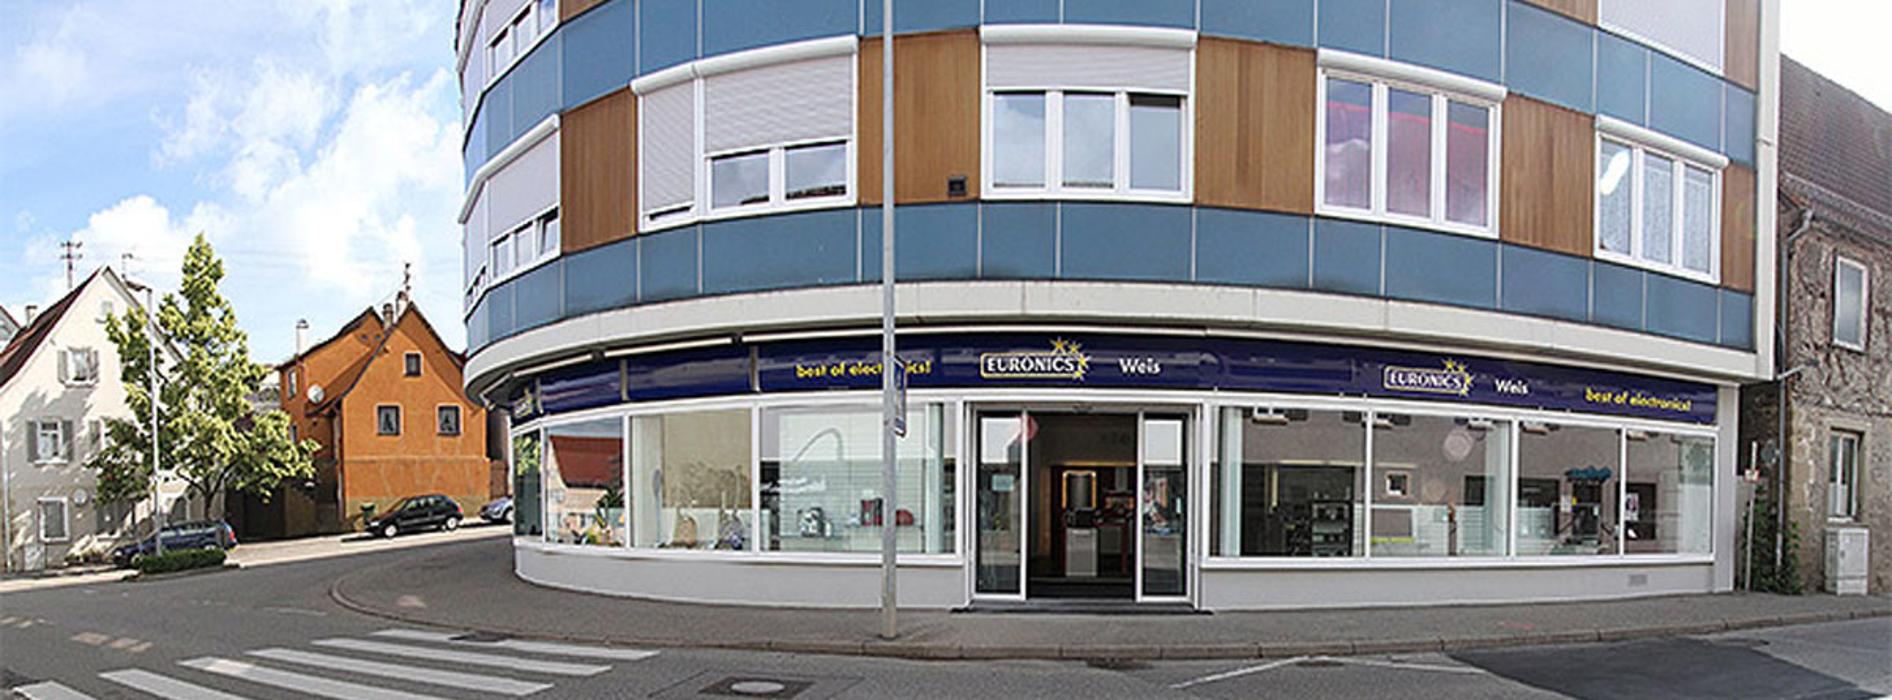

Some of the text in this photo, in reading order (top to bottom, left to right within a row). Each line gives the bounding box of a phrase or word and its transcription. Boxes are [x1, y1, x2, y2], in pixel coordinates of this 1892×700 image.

[796, 360, 932, 378] best of electics!
[986, 357, 1075, 373] EURONICS
[1118, 357, 1161, 374] Weis
[1389, 372, 1462, 390] EURONICS
[1495, 378, 1529, 395] Weis
[1585, 386, 1612, 403] best
[1614, 390, 1628, 404] of
